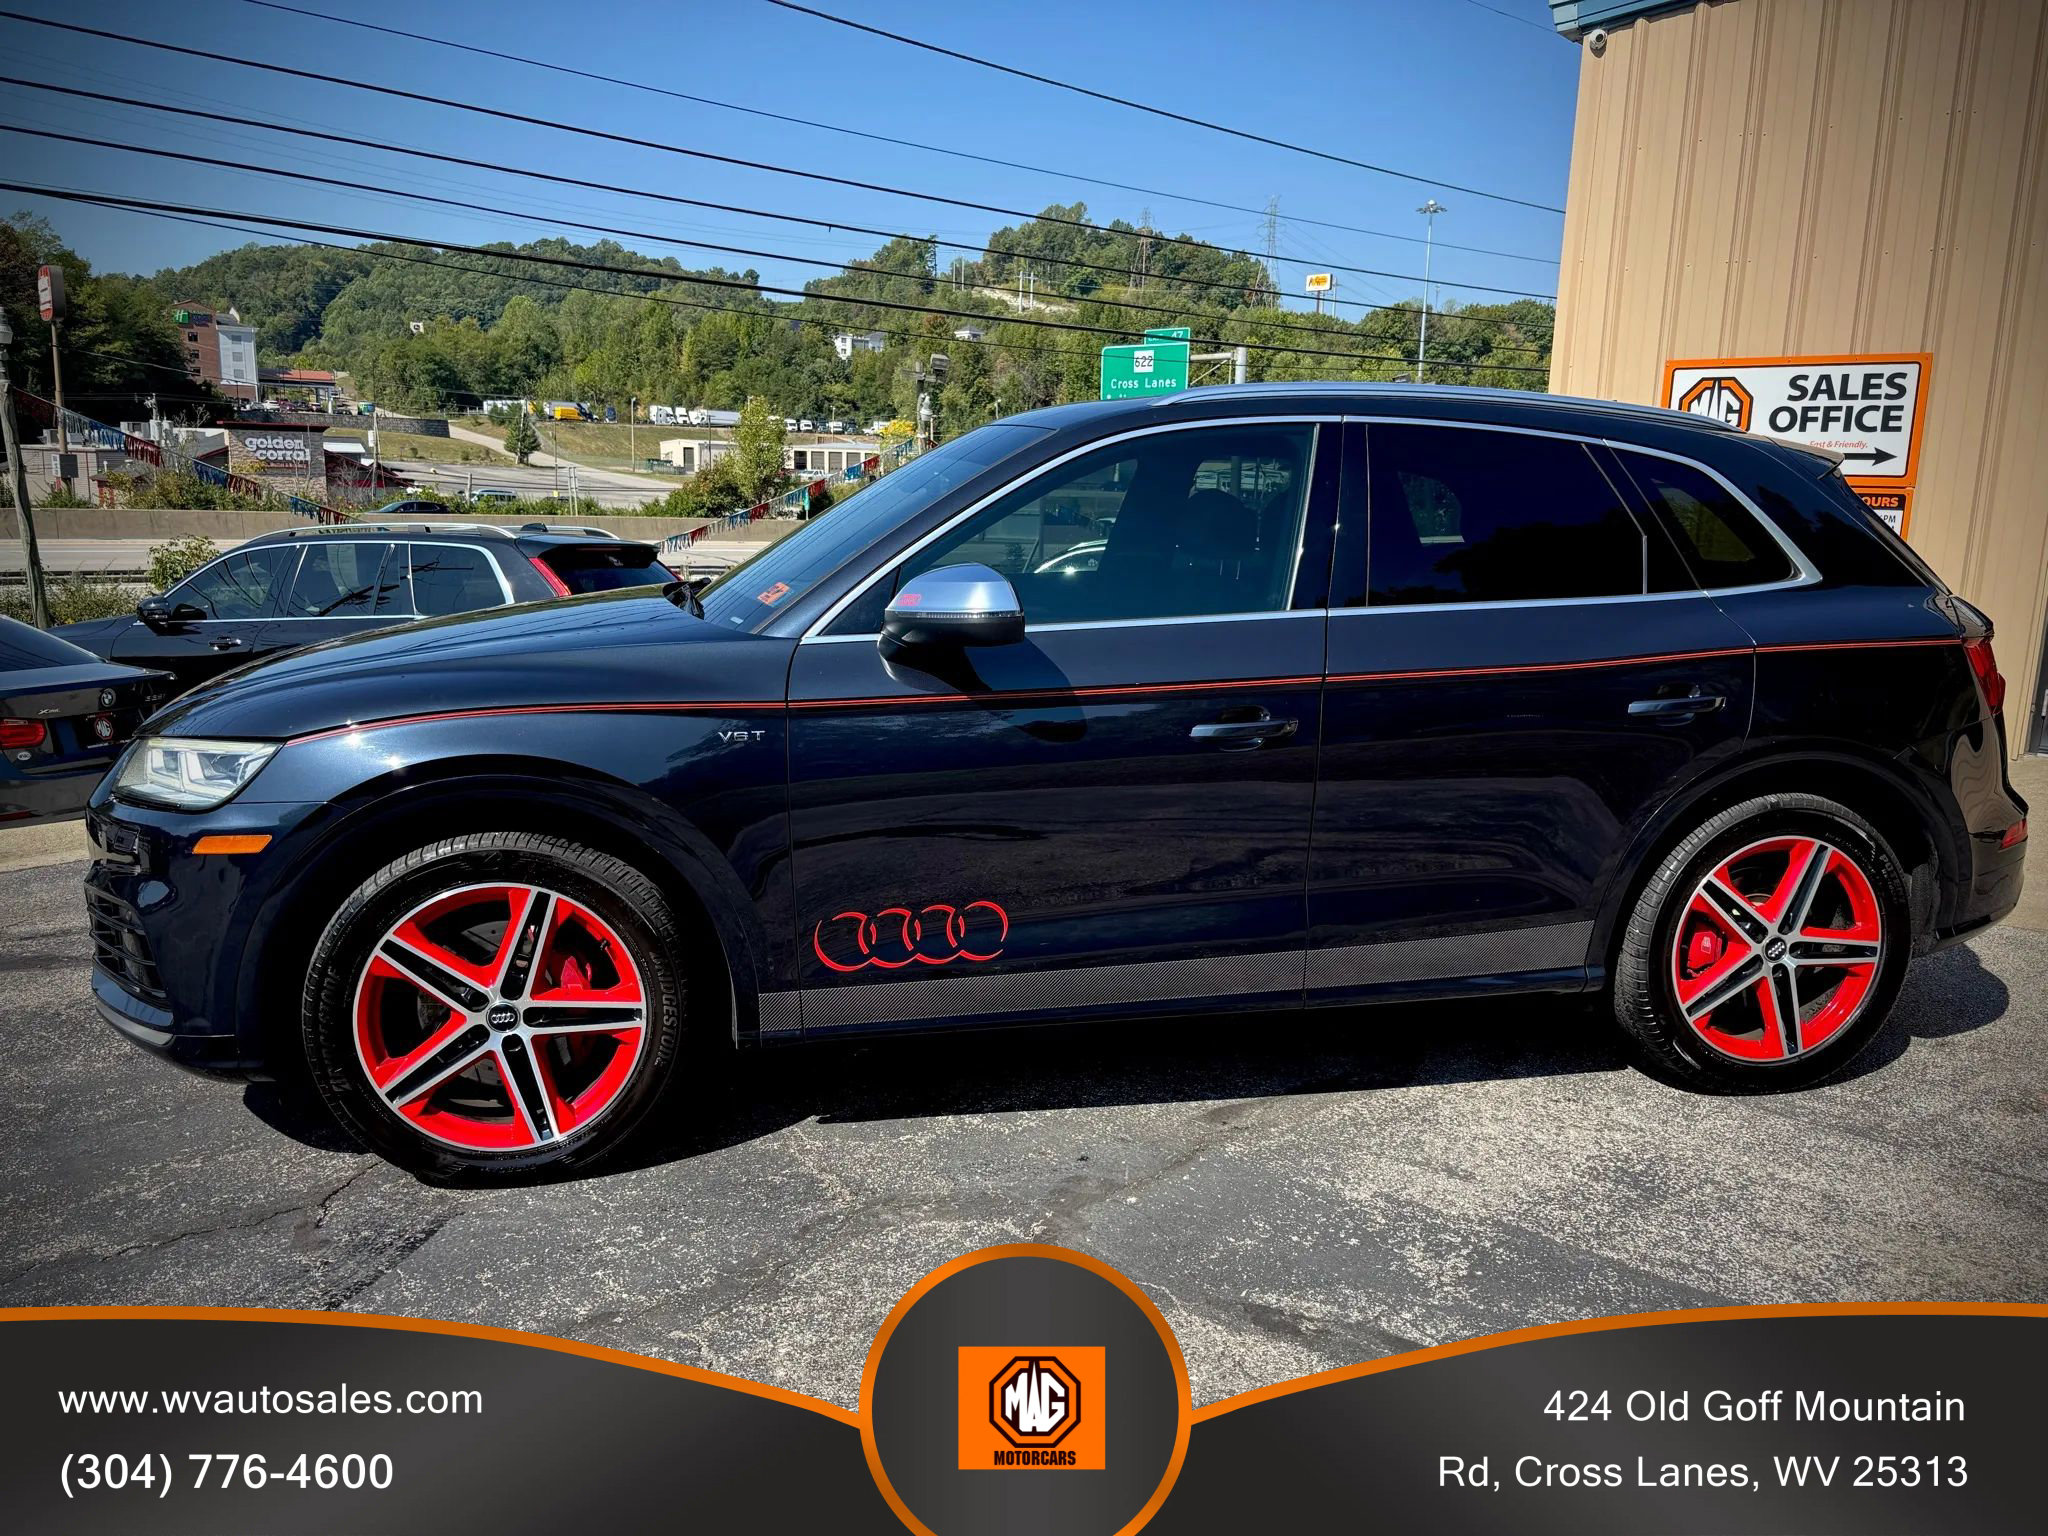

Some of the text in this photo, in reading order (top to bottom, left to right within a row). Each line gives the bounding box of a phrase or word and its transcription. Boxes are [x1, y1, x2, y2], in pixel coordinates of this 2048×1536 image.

[1134, 355, 1153, 368] 622
[1110, 377, 1177, 389] Cross Lanes
[1787, 372, 1908, 402] SALES
[1768, 404, 1905, 433] OFFICE
[244, 435, 303, 451] golden
[255, 448, 311, 461] corral
[1861, 496, 1899, 507] OURS
[1880, 514, 1896, 523] PM
